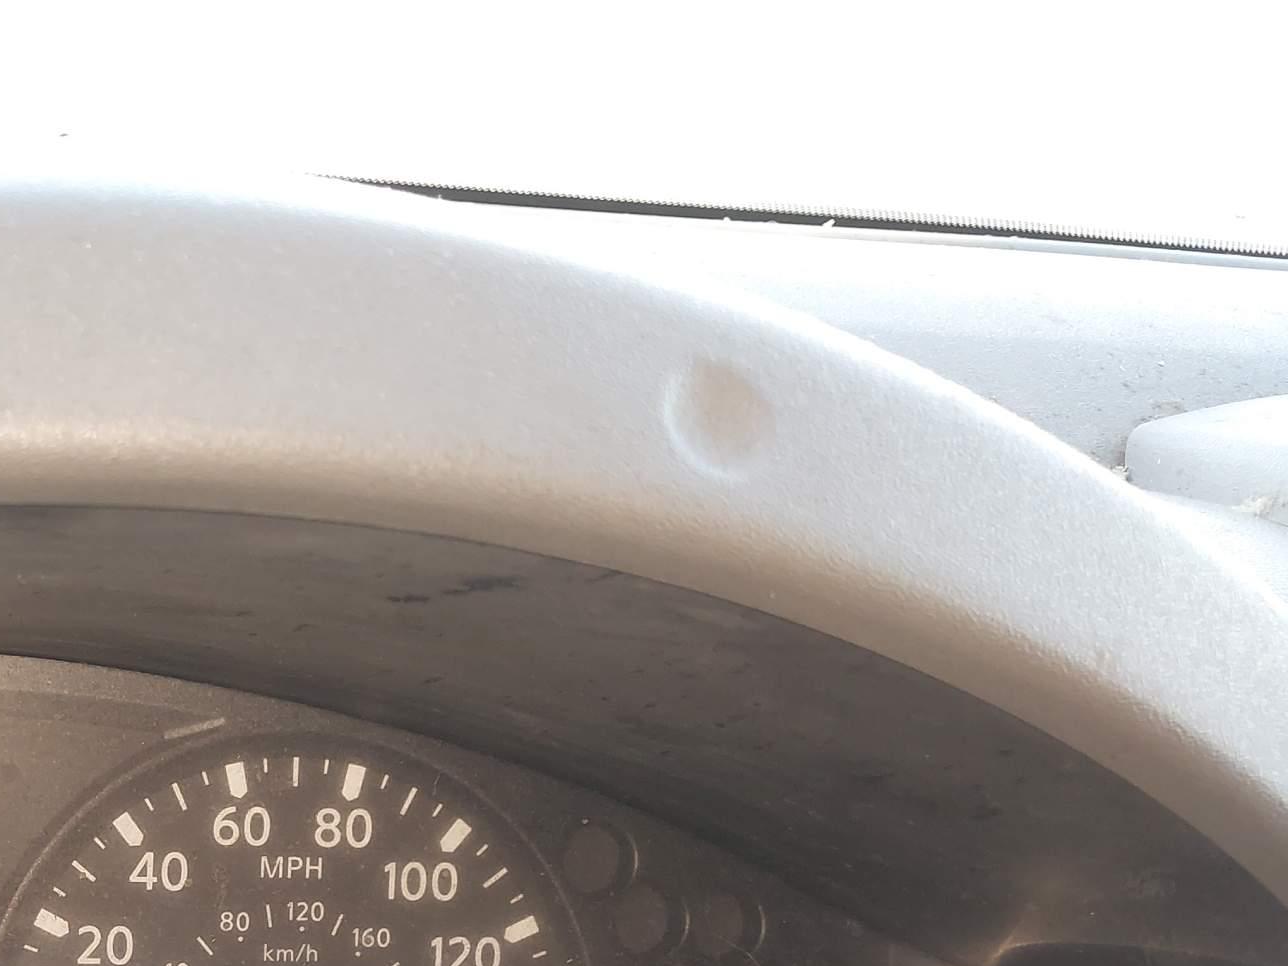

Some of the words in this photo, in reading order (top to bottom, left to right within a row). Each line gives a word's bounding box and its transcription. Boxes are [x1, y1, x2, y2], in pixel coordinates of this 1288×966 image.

[213, 806, 271, 847] 60
[314, 807, 372, 849] 80
[129, 851, 188, 892] 40
[259, 855, 324, 880] MPH
[383, 861, 458, 902] 100
[220, 911, 251, 933] 80
[287, 901, 325, 923] 120
[77, 925, 134, 966] 20
[263, 943, 319, 963] km/h
[352, 927, 391, 949] 160
